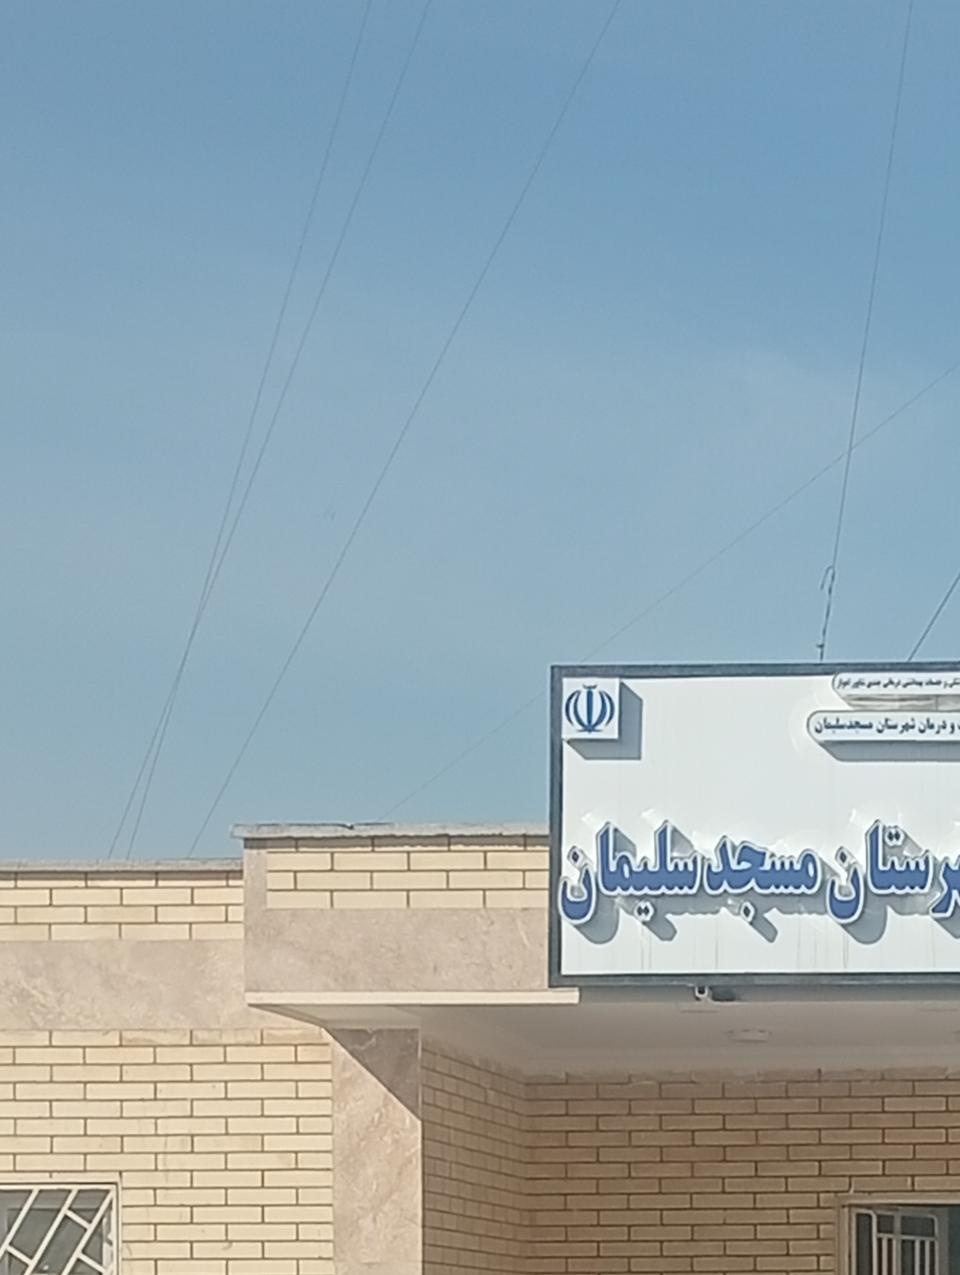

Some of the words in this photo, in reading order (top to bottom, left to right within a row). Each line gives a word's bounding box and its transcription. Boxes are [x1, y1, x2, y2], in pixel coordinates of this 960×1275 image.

[814, 716, 873, 734] مسجدسلیمان
[875, 716, 916, 735] شهرستان
[918, 717, 947, 735] درمان
